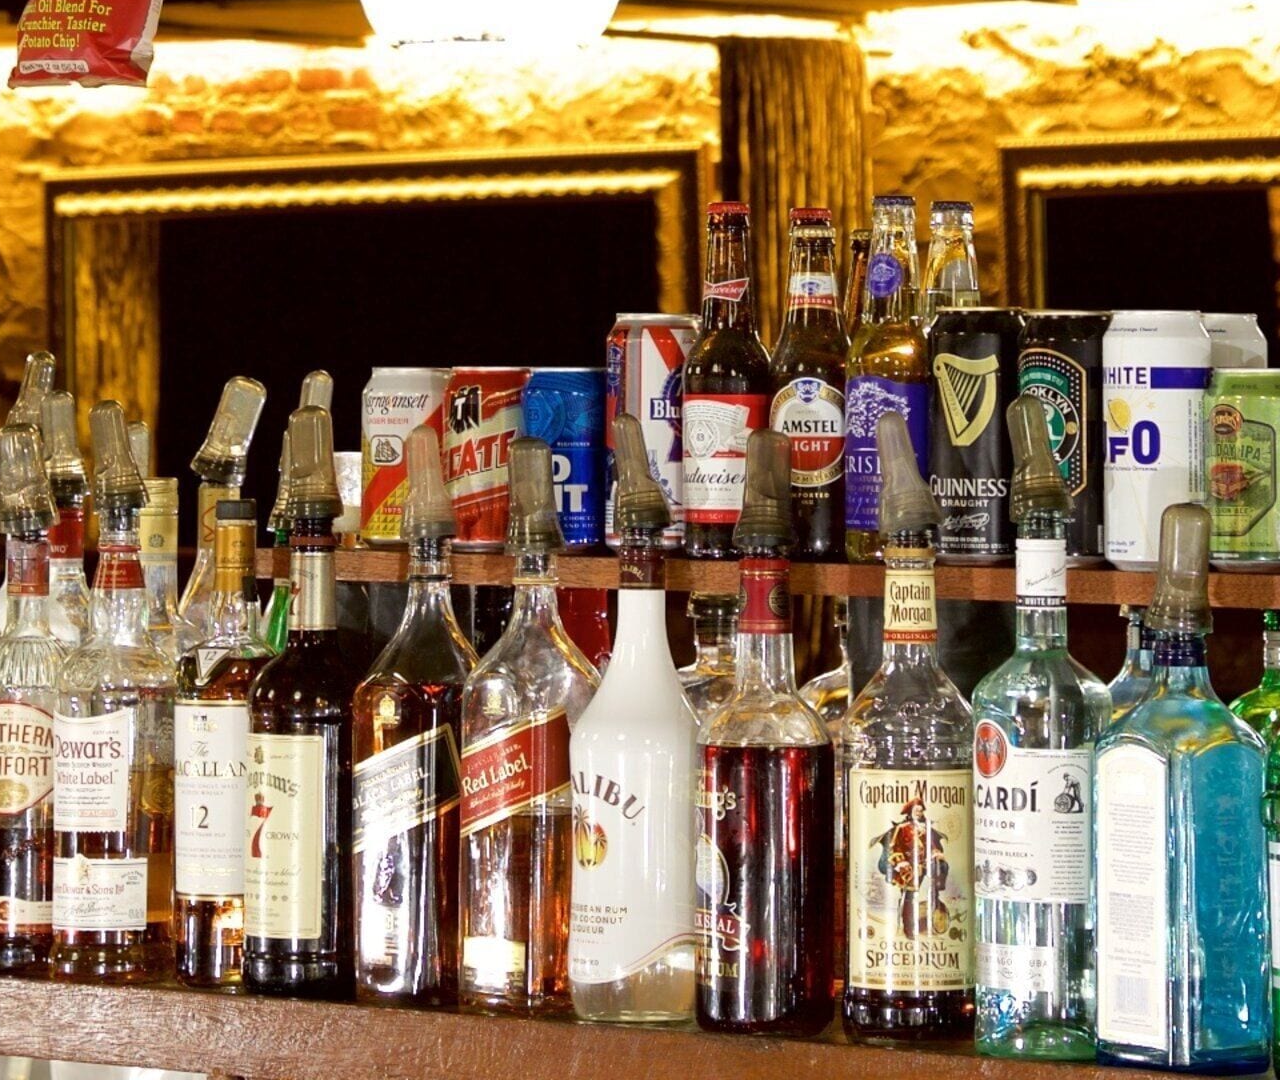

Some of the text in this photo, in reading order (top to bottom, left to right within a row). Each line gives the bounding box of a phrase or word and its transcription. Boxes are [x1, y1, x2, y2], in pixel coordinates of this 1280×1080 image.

[39, 0, 112, 15] Oil Blend For
[68, 16, 105, 32] Tastier
[23, 34, 51, 48] Potato
[651, 399, 681, 419] Blu
[782, 420, 838, 433] AMSTEL
[1106, 420, 1161, 465] FO
[1241, 446, 1261, 461] IPA
[930, 474, 1007, 498] GUINNESS
[941, 499, 989, 507] DRAUGHT
[890, 581, 930, 603] Captain
[889, 605, 932, 626] Morgan
[391, 767, 429, 790] LABEL
[462, 777, 487, 797] Red
[491, 754, 528, 783] Label
[860, 779, 966, 809] Captain Morgan
[192, 805, 209, 829] 12
[251, 805, 273, 858] 7
[266, 831, 299, 840] CROWN
[605, 906, 627, 914] RUM
[926, 952, 959, 969] RUM
